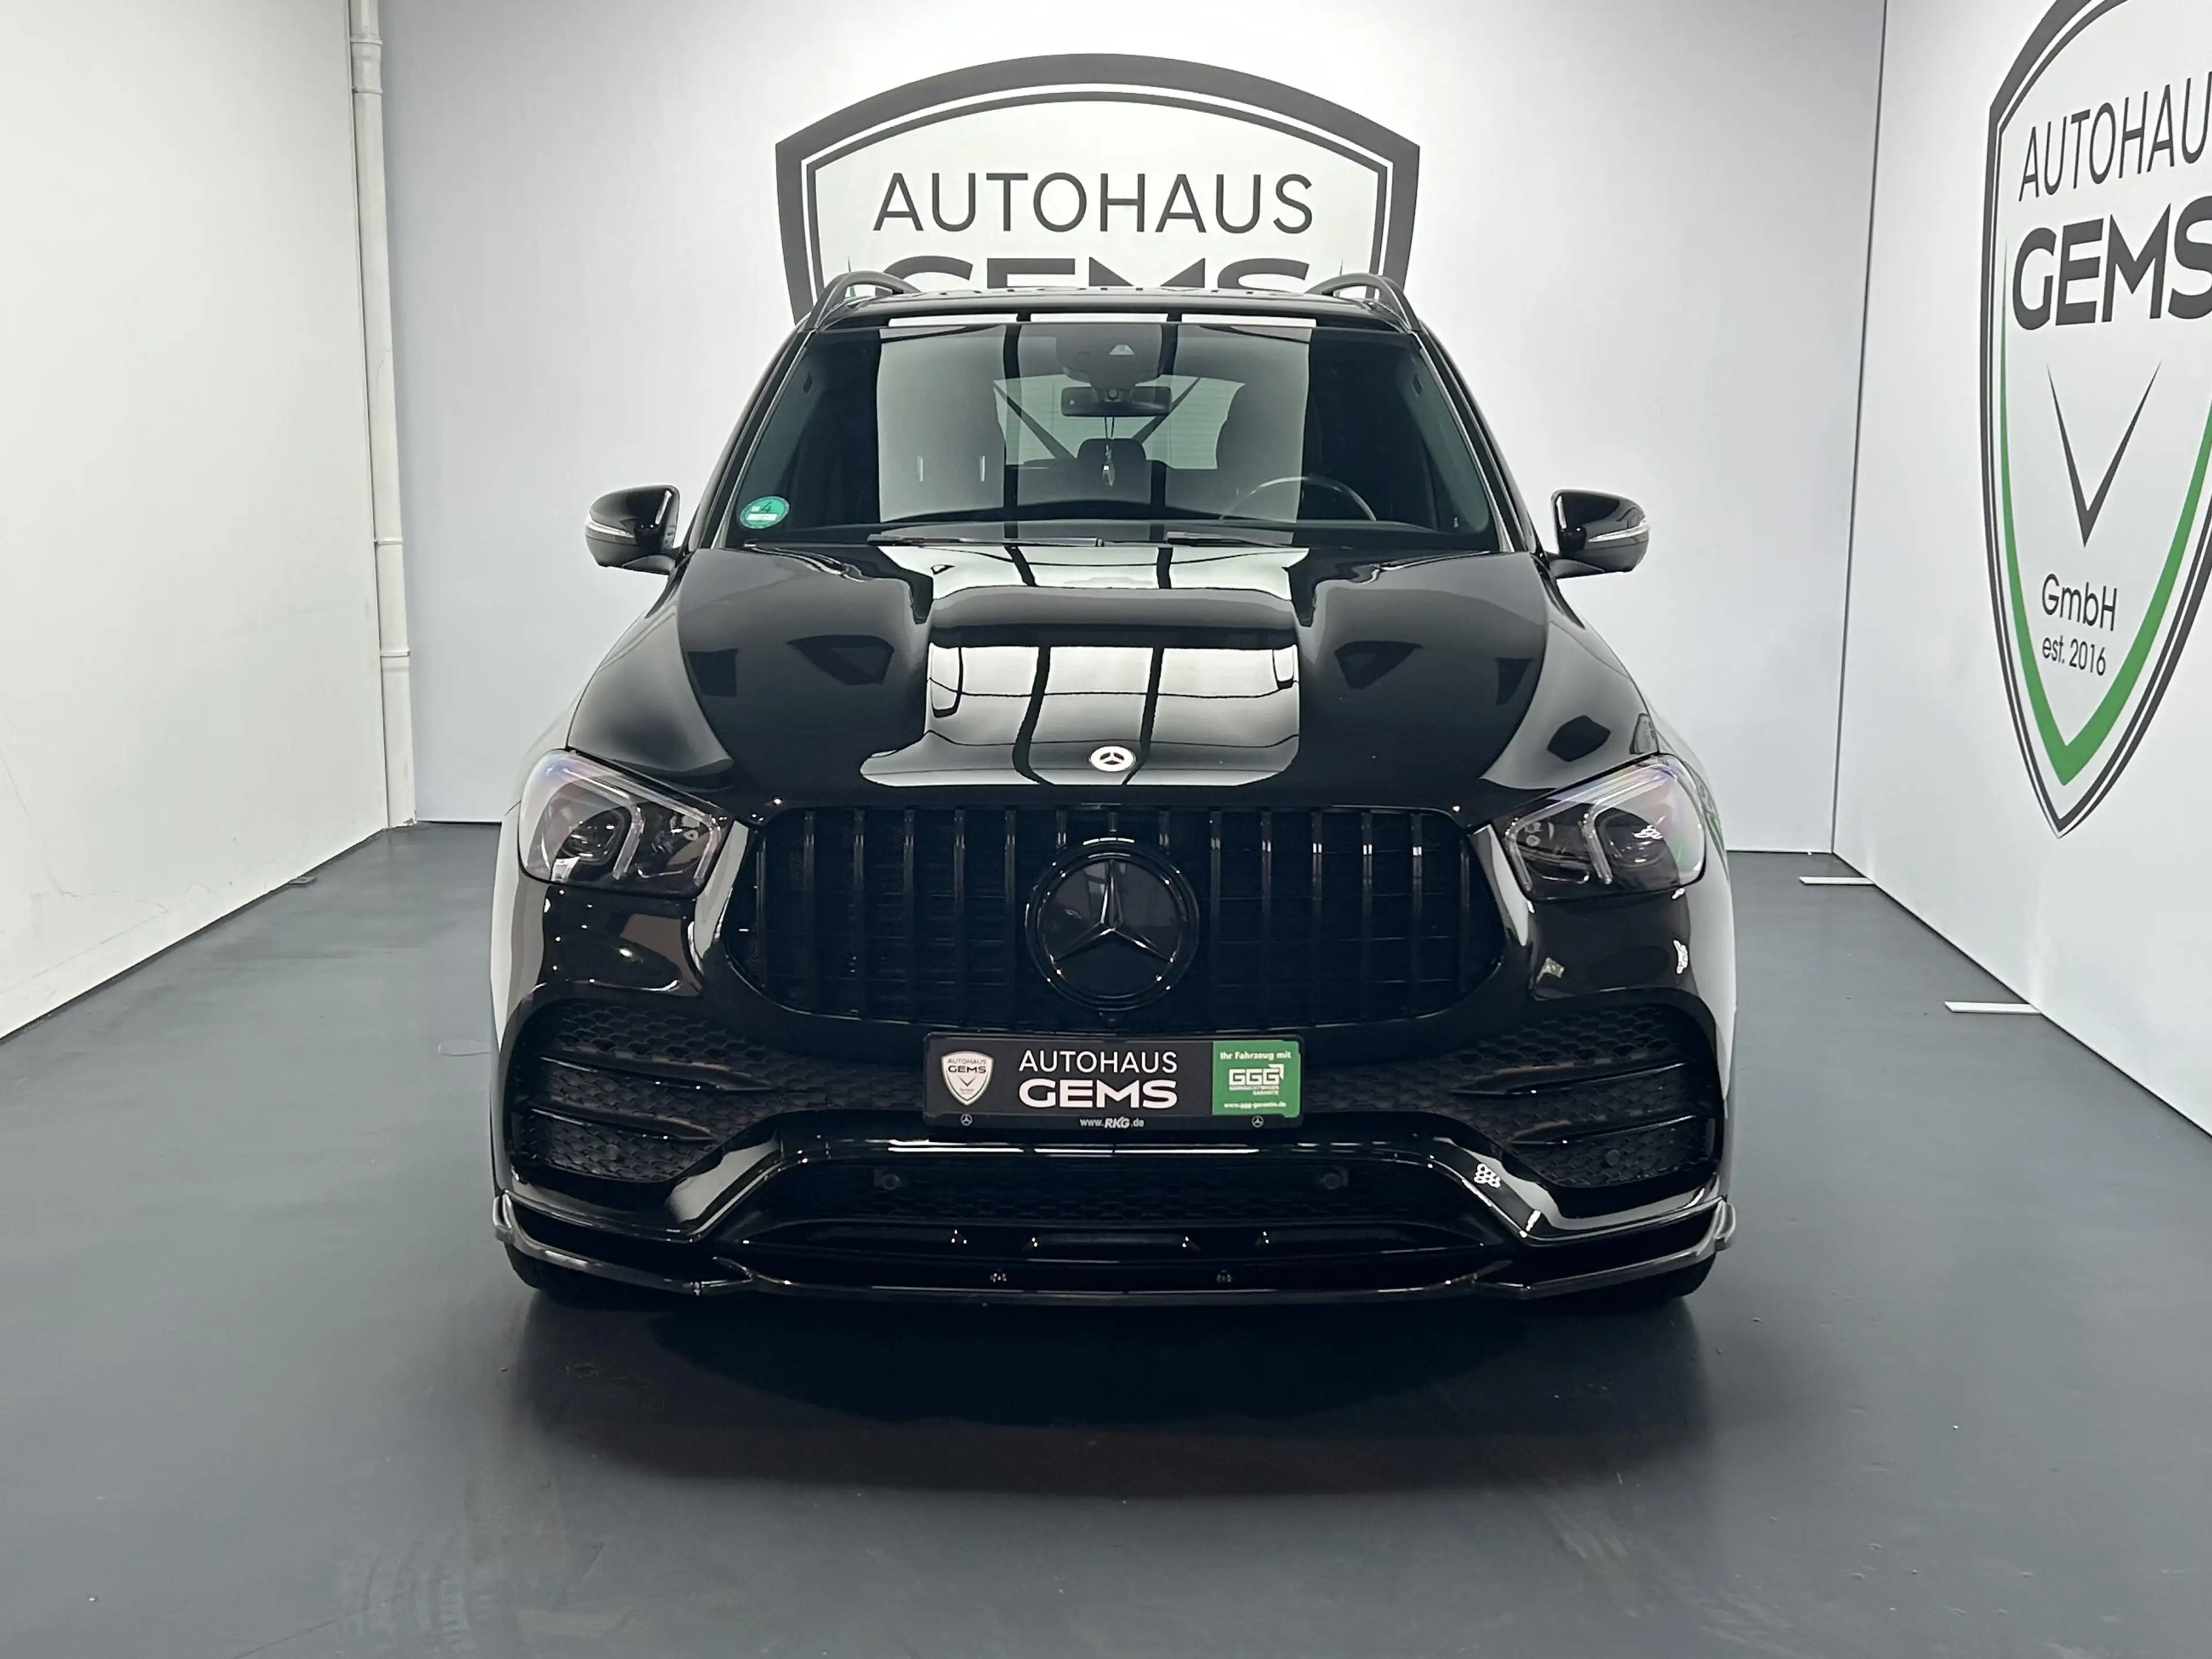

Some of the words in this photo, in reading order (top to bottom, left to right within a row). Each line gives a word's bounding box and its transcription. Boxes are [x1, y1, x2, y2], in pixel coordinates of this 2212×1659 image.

[873, 172, 1313, 234] AUTOHAUS
[2013, 195, 2212, 330] GEMS
[761, 501, 772, 513] 4
[2042, 573, 2118, 631] GmbH
[2042, 635, 2066, 664] est.
[2069, 638, 2106, 676] 2016
[1018, 1050, 1177, 1073] AUTOHAUS
[1220, 1051, 1233, 1060] Ihr
[1234, 1051, 1274, 1060] Fahrzeug
[1277, 1051, 1291, 1059] mit
[948, 1065, 986, 1074] GEMS
[1019, 1078, 1177, 1109] GEMS
[1080, 1116, 1145, 1128] www.RKG.de
